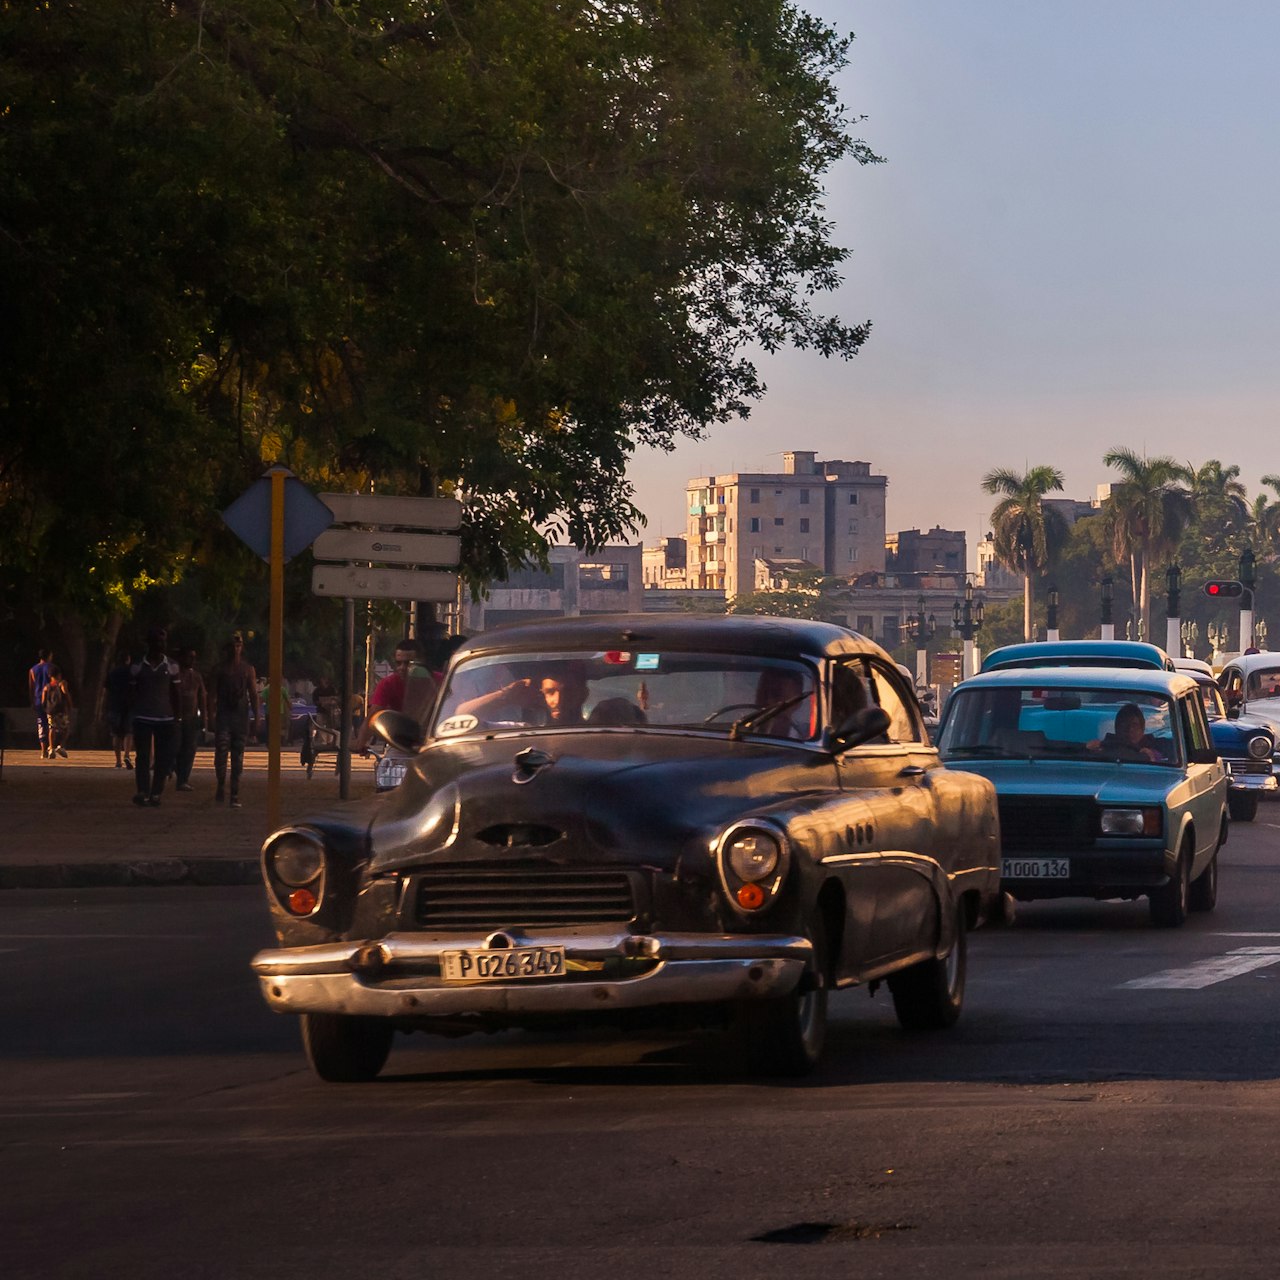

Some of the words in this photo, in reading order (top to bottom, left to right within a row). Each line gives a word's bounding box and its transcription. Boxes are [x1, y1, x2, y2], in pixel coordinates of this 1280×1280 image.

[1014, 862, 1040, 877] 000
[1042, 861, 1068, 877] 136
[459, 954, 473, 977] P
[477, 953, 516, 977] 026
[520, 949, 561, 973] 349
